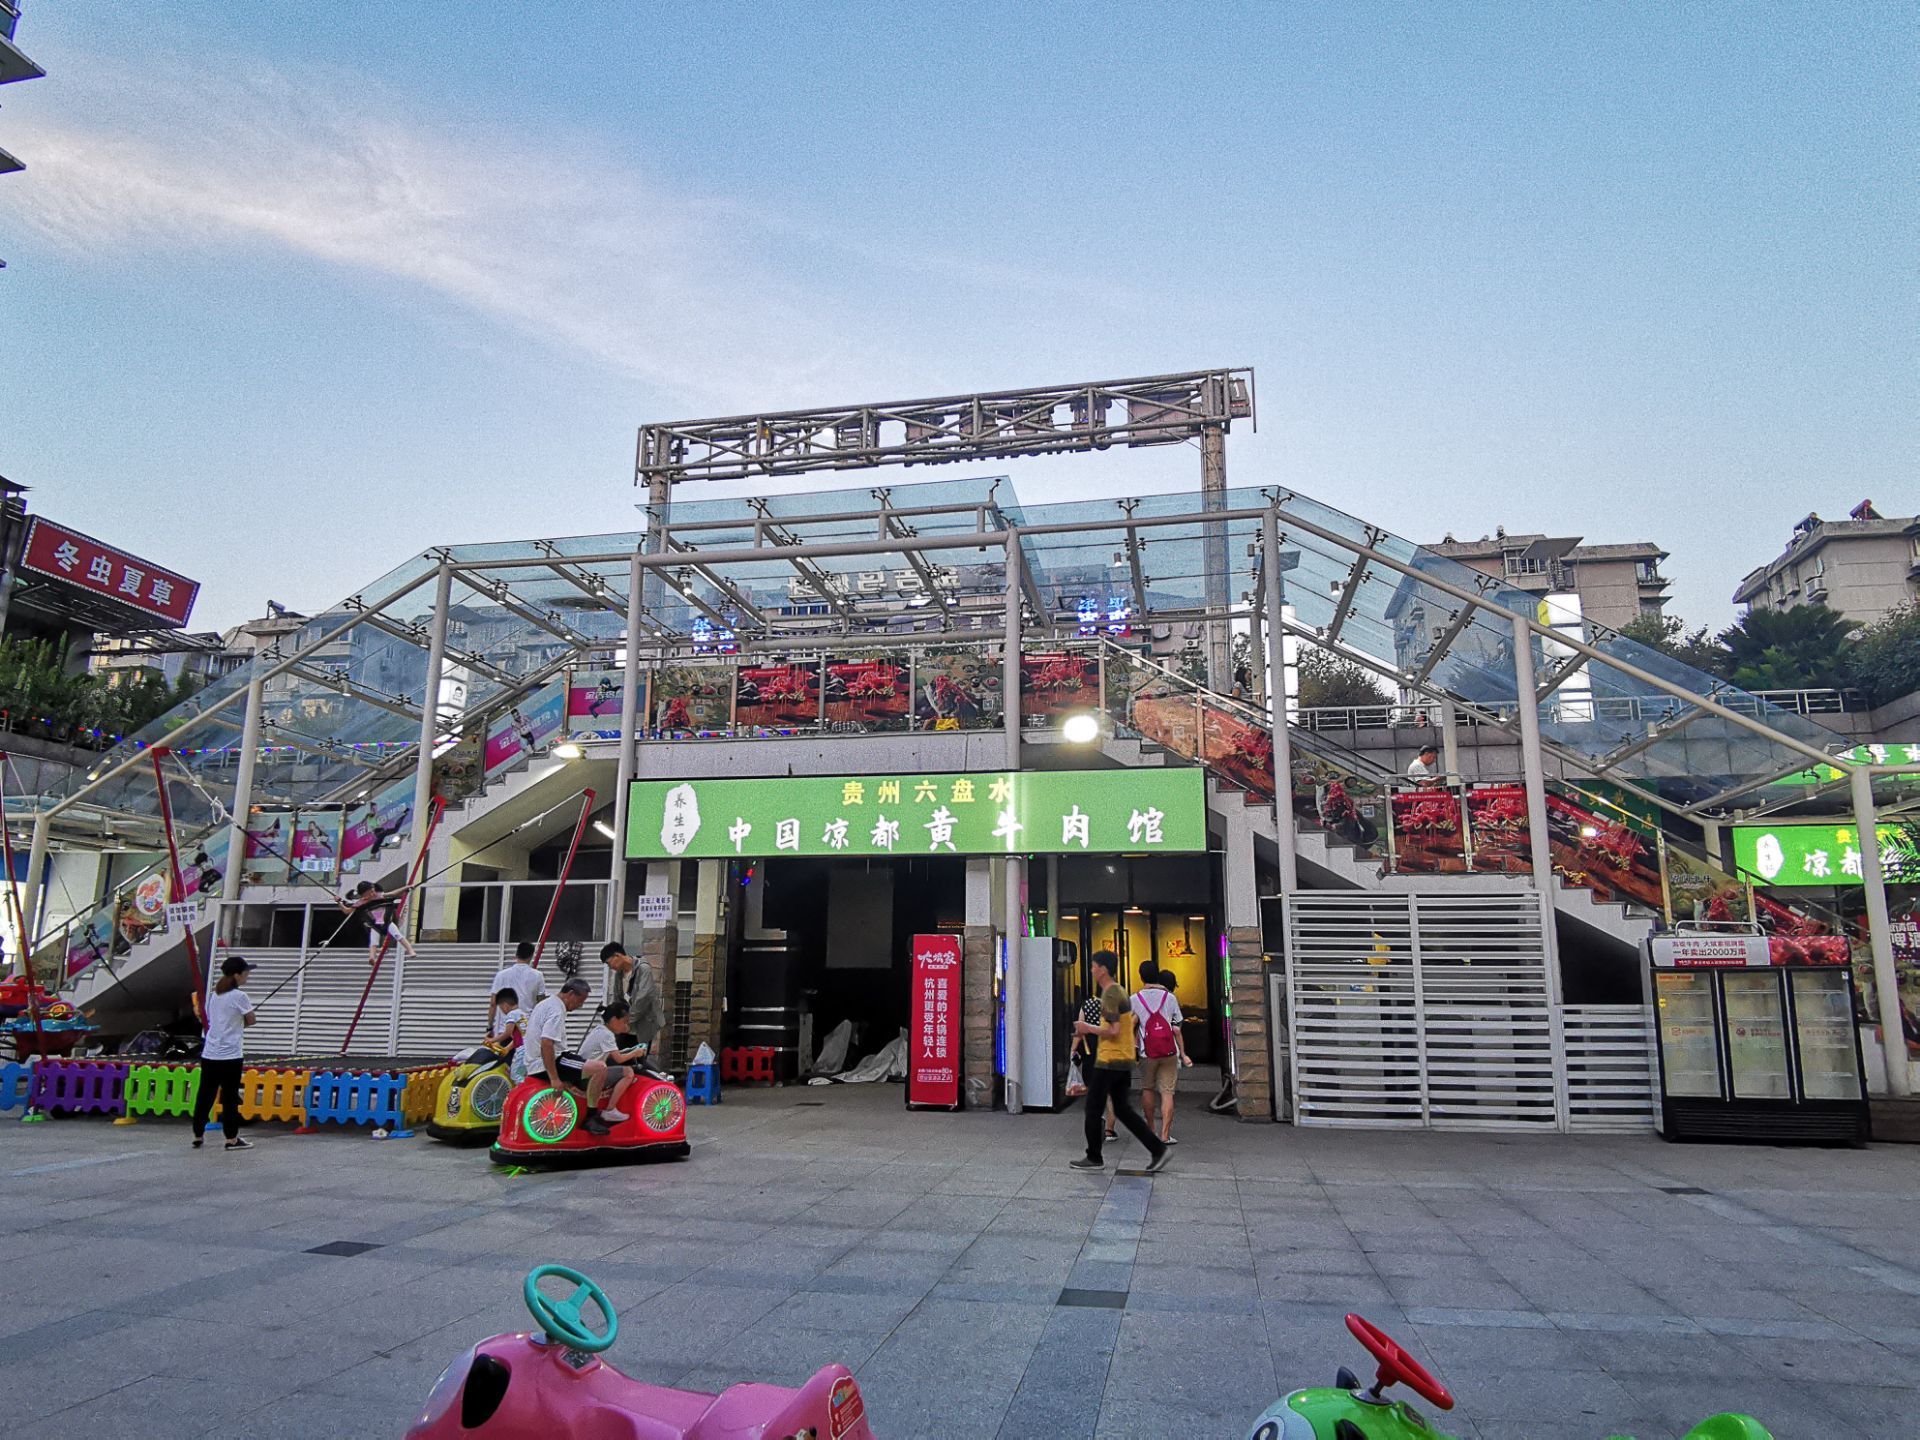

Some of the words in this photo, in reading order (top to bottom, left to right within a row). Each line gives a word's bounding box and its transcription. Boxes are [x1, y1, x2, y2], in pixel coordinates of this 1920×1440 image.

[54, 540, 174, 606] 冬虫夏草
[671, 791, 687, 846] 养生锅
[842, 778, 1012, 807] 贵州六盘水
[728, 804, 1164, 853] 中国凉都黄牛肉馆
[923, 978, 935, 1058] 杭州更受年轻人
[936, 977, 948, 1058] 喜爱的火锅连锁
